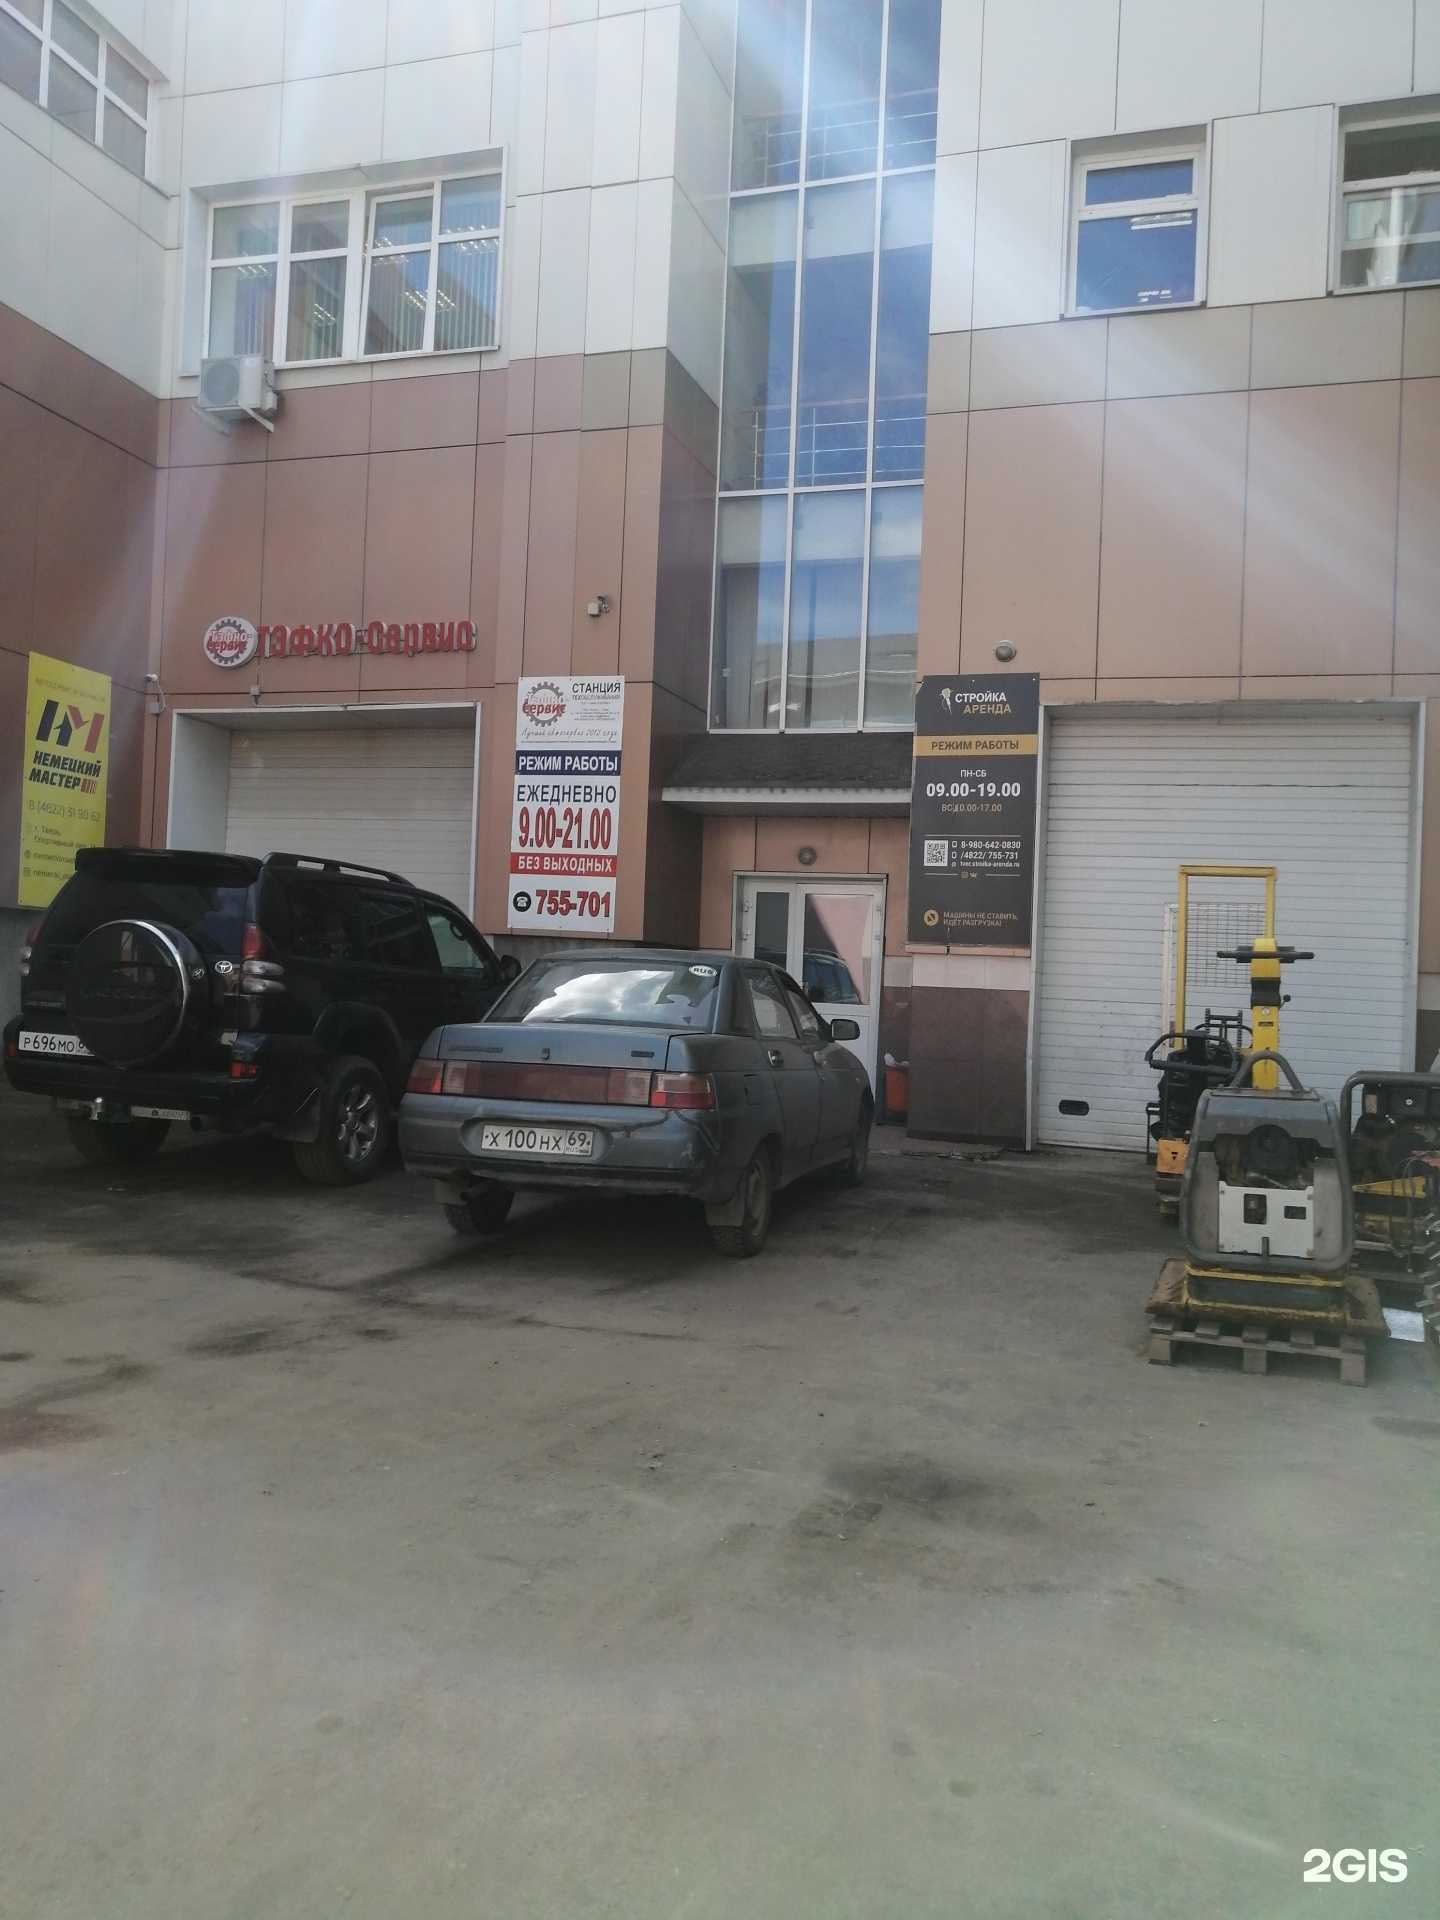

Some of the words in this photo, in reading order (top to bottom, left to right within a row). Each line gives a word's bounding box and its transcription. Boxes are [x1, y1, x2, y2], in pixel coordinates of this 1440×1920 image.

[572, 683, 621, 695] СТАНЦИЯ
[955, 690, 1007, 703] СТРОЙКА
[963, 703, 1012, 715] АРЕНДА
[932, 741, 972, 751] РЕЖИМ
[975, 740, 1019, 751] РАБОТЫ
[33, 750, 102, 778] НЕМЕЦКИЙ
[518, 756, 562, 771] РЕЖИМ
[565, 756, 618, 772] РАБОТЫ
[29, 768, 81, 790] МАСТЕР
[960, 769, 987, 778] ПН-СБ
[517, 785, 617, 805] ЕЖЕДНЕВНО
[926, 782, 1021, 797] 09.00-19.00
[518, 807, 612, 849] 9.00-21.00
[960, 841, 1021, 849] 8-980-642-0830
[988, 851, 1018, 860] 755-731
[518, 856, 540, 870] БЕЗ
[543, 857, 612, 874] ВЫХОДНЫХ
[535, 889, 612, 918] 755-701
